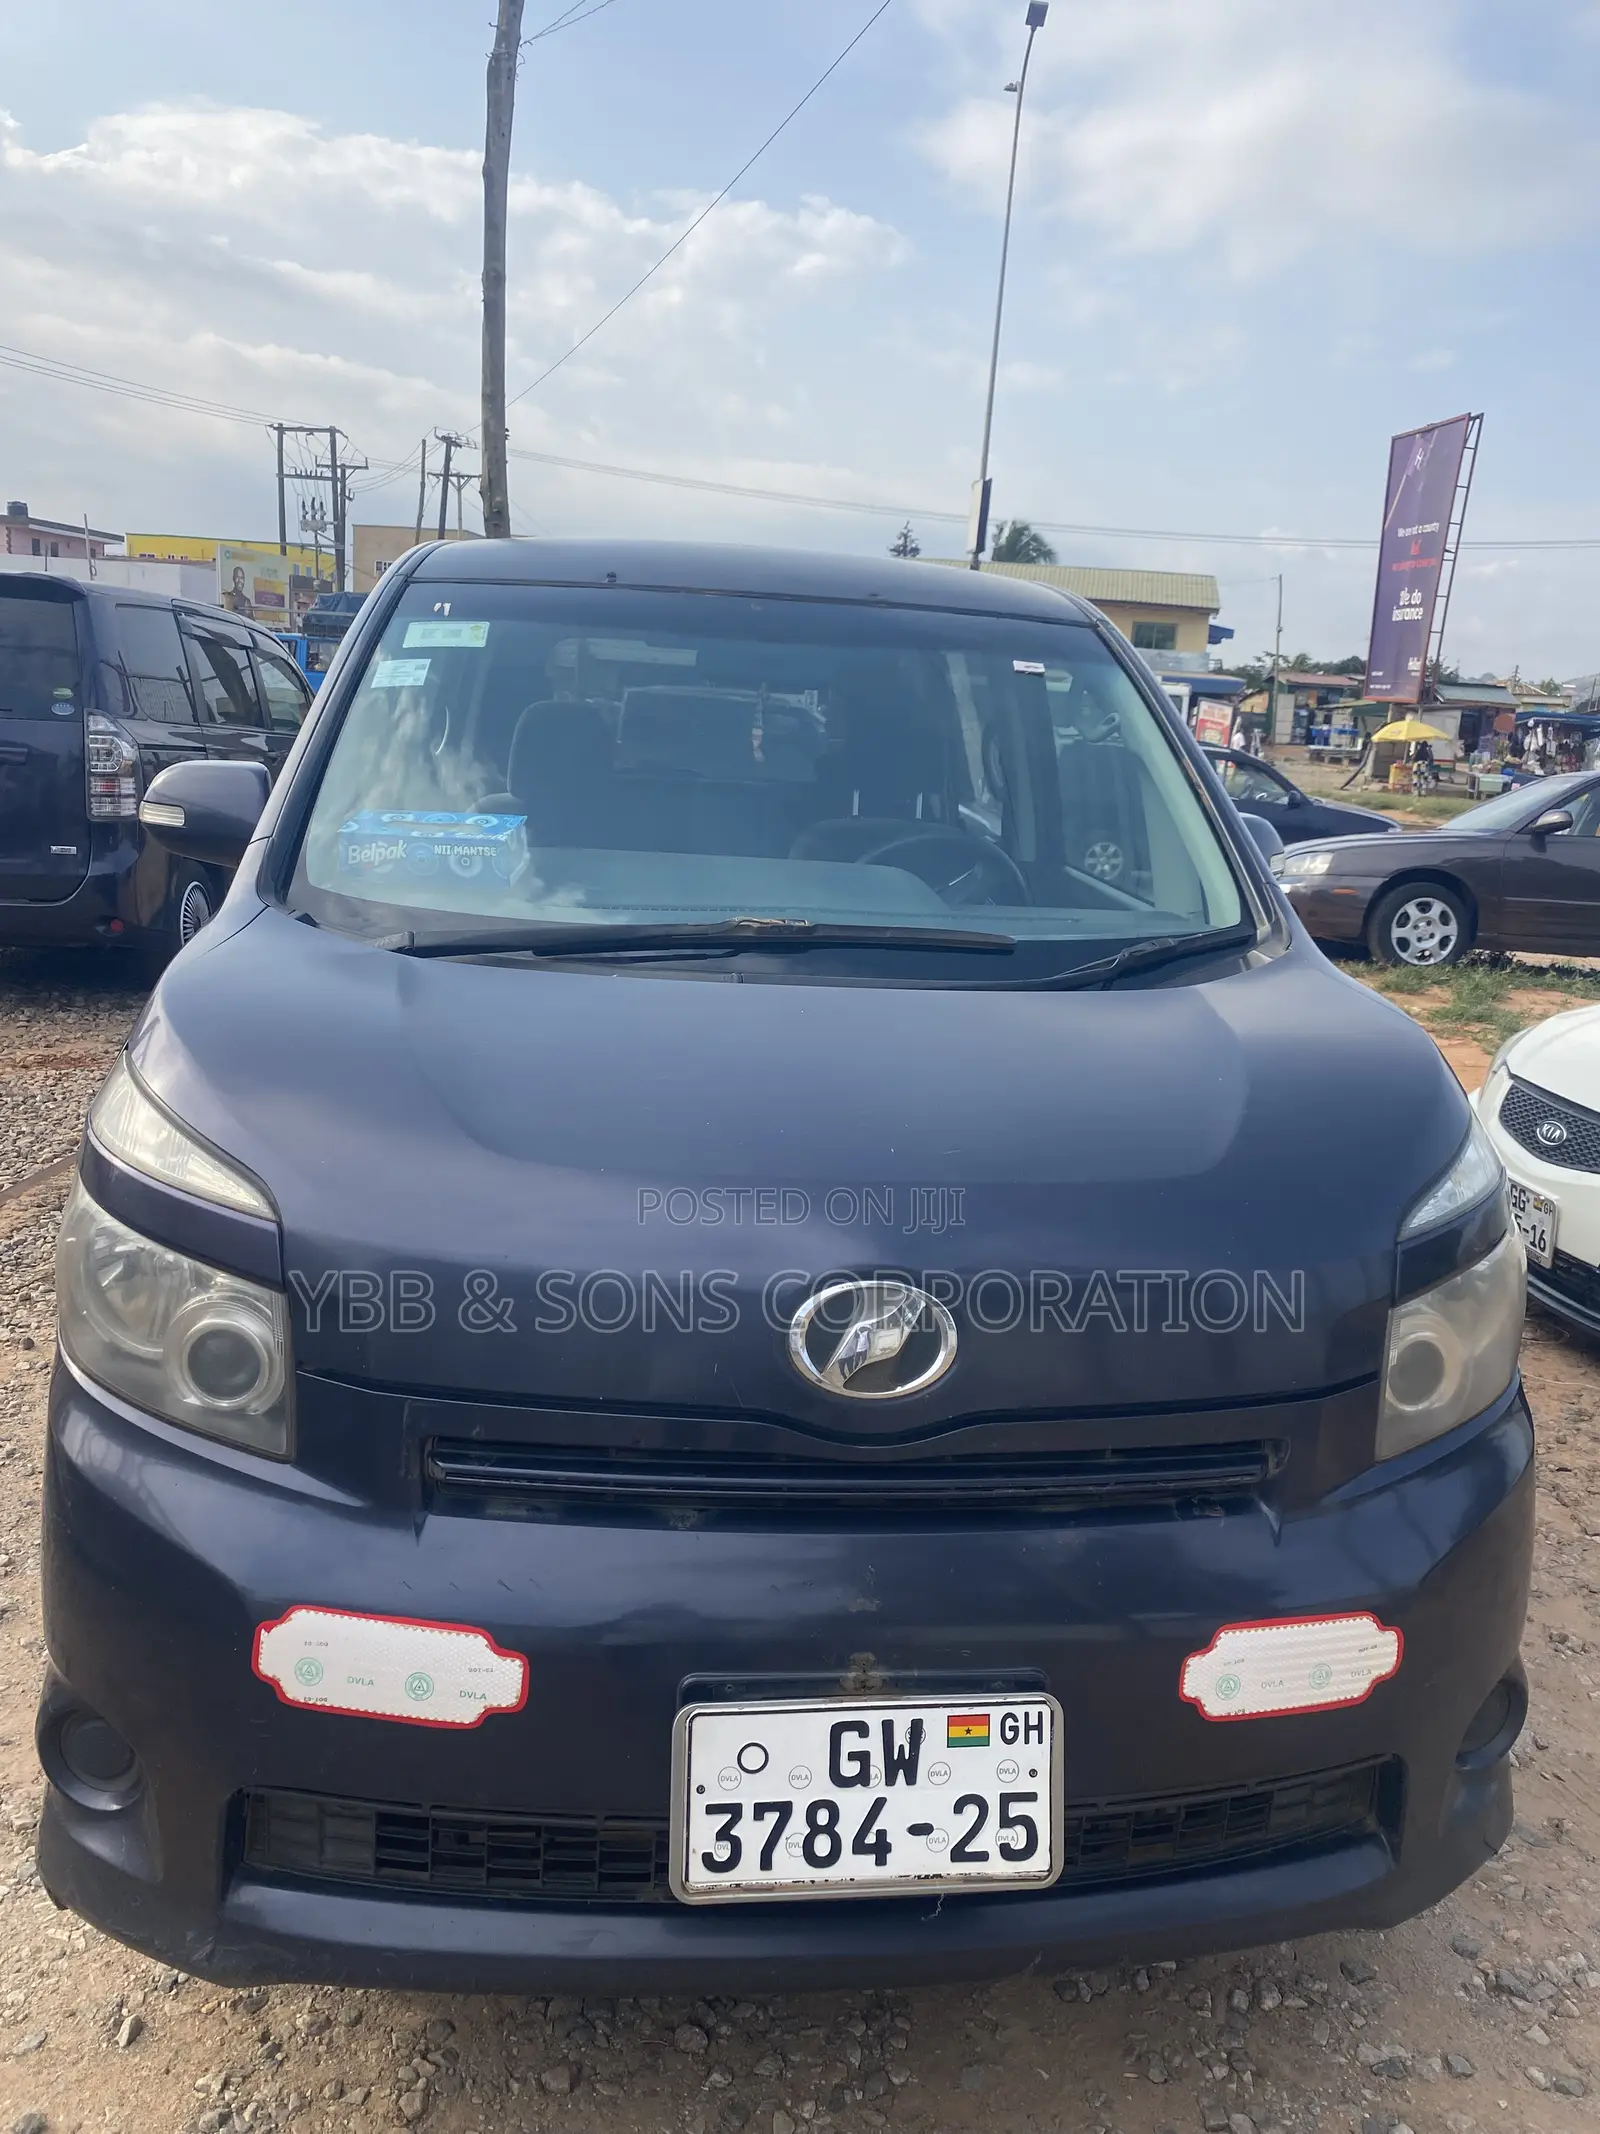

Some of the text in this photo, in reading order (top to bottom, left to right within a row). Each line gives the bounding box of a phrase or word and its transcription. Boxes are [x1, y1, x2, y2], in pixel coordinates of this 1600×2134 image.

[1410, 588, 1422, 605] do
[348, 840, 408, 866] Belpak
[434, 845, 497, 857] NII MANTSE
[1541, 1122, 1561, 1140] KIA
[346, 1676, 375, 1687] DVLA
[1260, 1680, 1285, 1689] DVLA
[459, 1690, 487, 1701] DVLA
[1000, 1711, 1044, 1746] GH
[828, 1718, 924, 1788] GW
[930, 1770, 949, 1778] DVLA
[999, 1767, 1017, 1776] DVLA
[720, 1775, 739, 1783] DVLA
[701, 1792, 1039, 1874] 3784-25
[929, 1836, 947, 1844] DVLA
